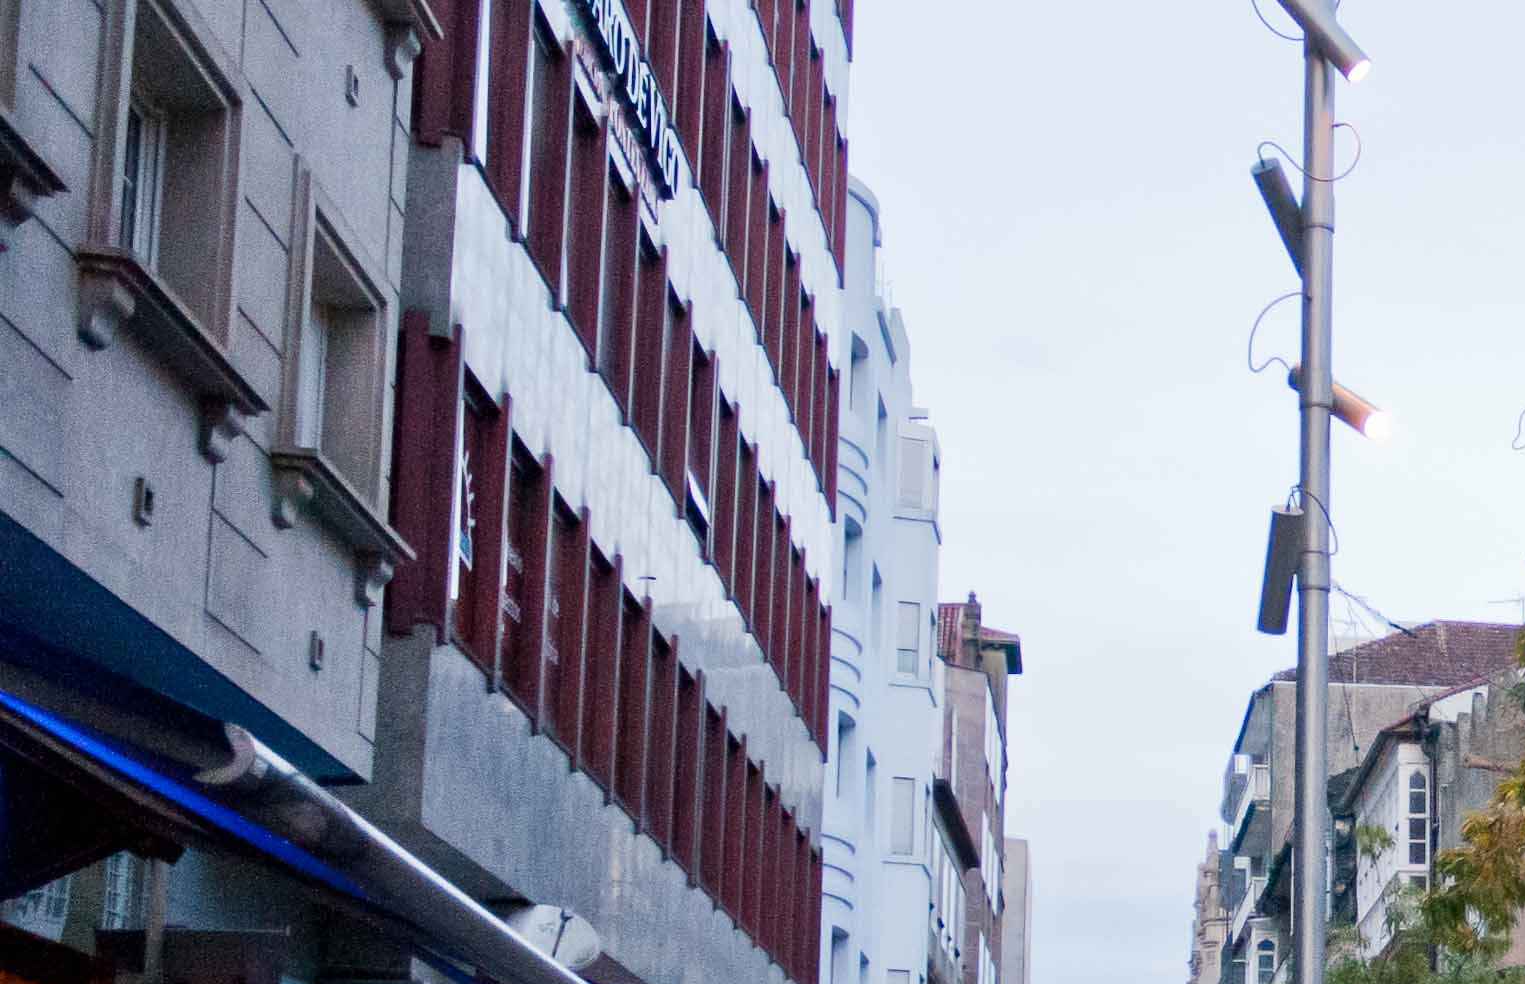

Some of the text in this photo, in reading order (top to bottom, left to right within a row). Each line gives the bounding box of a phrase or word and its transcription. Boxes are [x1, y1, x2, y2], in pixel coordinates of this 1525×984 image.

[586, 0, 625, 75] ARO
[625, 35, 650, 129] DE
[649, 73, 680, 197] VIGO
